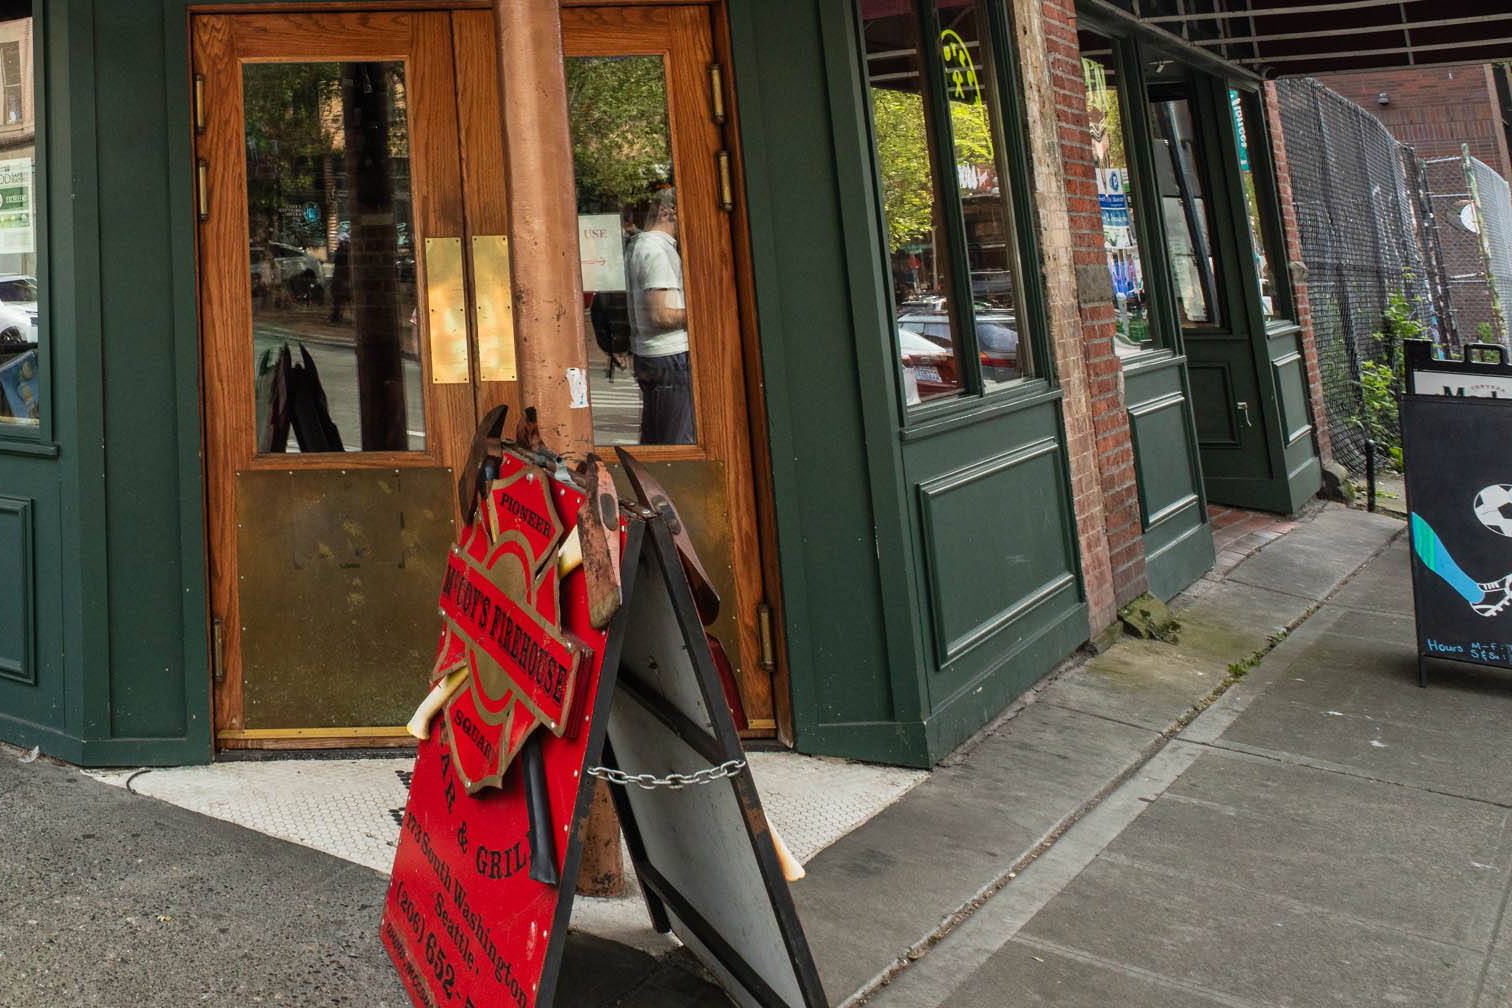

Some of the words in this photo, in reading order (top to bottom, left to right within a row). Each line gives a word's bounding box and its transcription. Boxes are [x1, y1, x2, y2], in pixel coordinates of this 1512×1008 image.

[583, 228, 608, 240] USE
[499, 492, 553, 539] PIONEER
[489, 604, 568, 706] FIREHOUSE
[1427, 639, 1464, 653] Hours
[457, 820, 469, 855] &
[475, 841, 528, 880] GRIL
[396, 881, 426, 944] (206)
[406, 811, 422, 843] 173
[421, 831, 452, 893] South
[453, 876, 528, 1008] Washington
